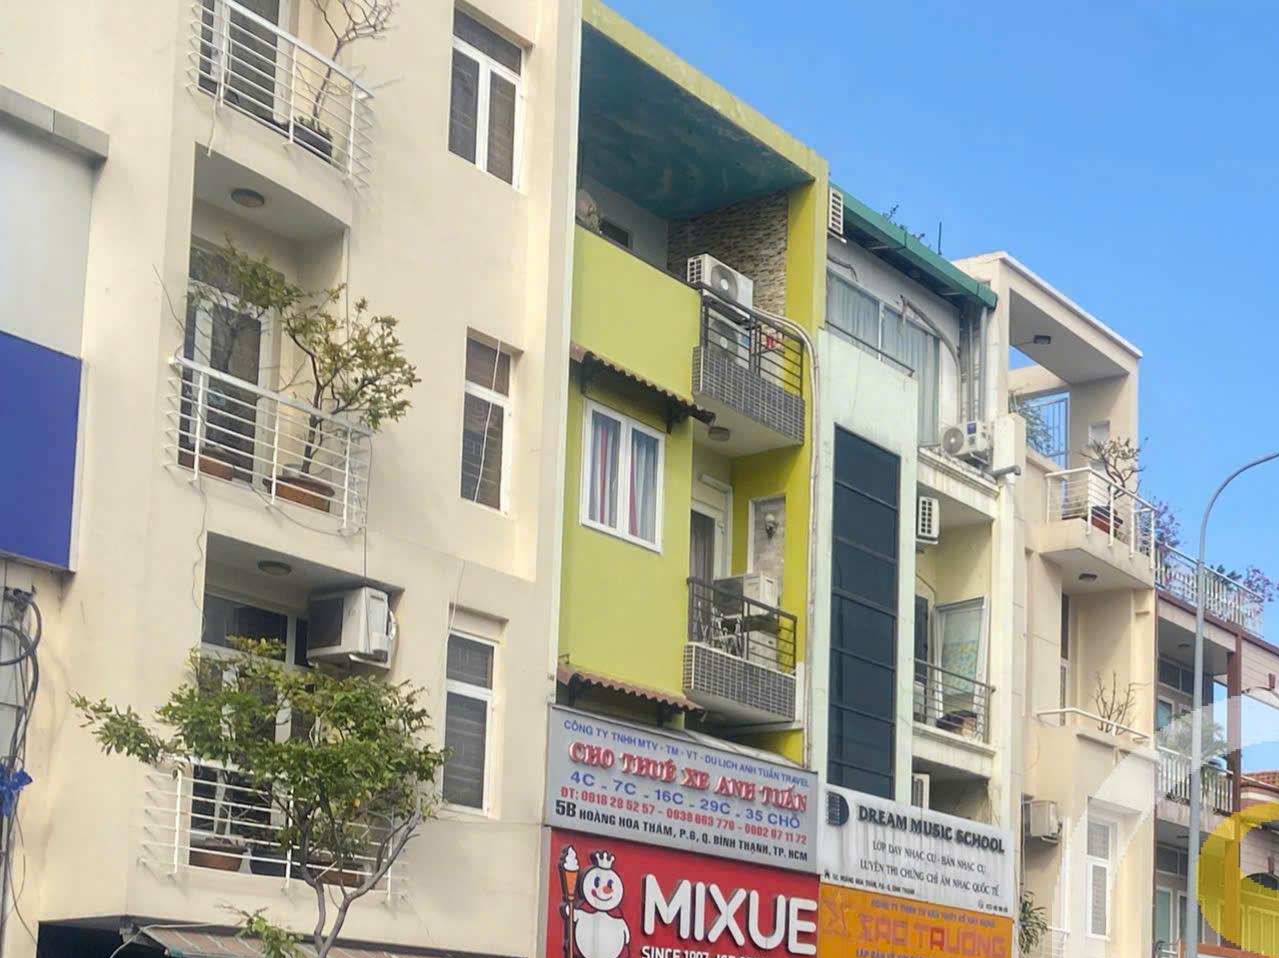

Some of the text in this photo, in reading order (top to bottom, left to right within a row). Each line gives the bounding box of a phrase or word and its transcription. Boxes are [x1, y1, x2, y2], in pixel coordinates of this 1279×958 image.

[564, 719, 593, 736] CÔNG
[596, 728, 608, 739] TY
[611, 732, 637, 745] TNHH
[638, 739, 658, 751] MTV
[740, 764, 757, 775] ANH
[569, 741, 615, 769] CHO
[680, 767, 710, 791] XE
[714, 775, 756, 802] ANH
[570, 770, 596, 787] 4C
[612, 779, 637, 796] 7C
[655, 788, 684, 806] 16C
[700, 798, 731, 815] 29C
[745, 807, 764, 823] 35
[555, 799, 576, 818] 5B
[579, 809, 616, 827] HOÀNG
[619, 817, 640, 831] HOA
[788, 848, 808, 862] HCM
[857, 804, 908, 832] DREAM
[910, 817, 953, 842] MUSIC
[955, 829, 1005, 855] SCHOOL
[887, 863, 899, 876] THI
[643, 873, 818, 956] MIXUE
